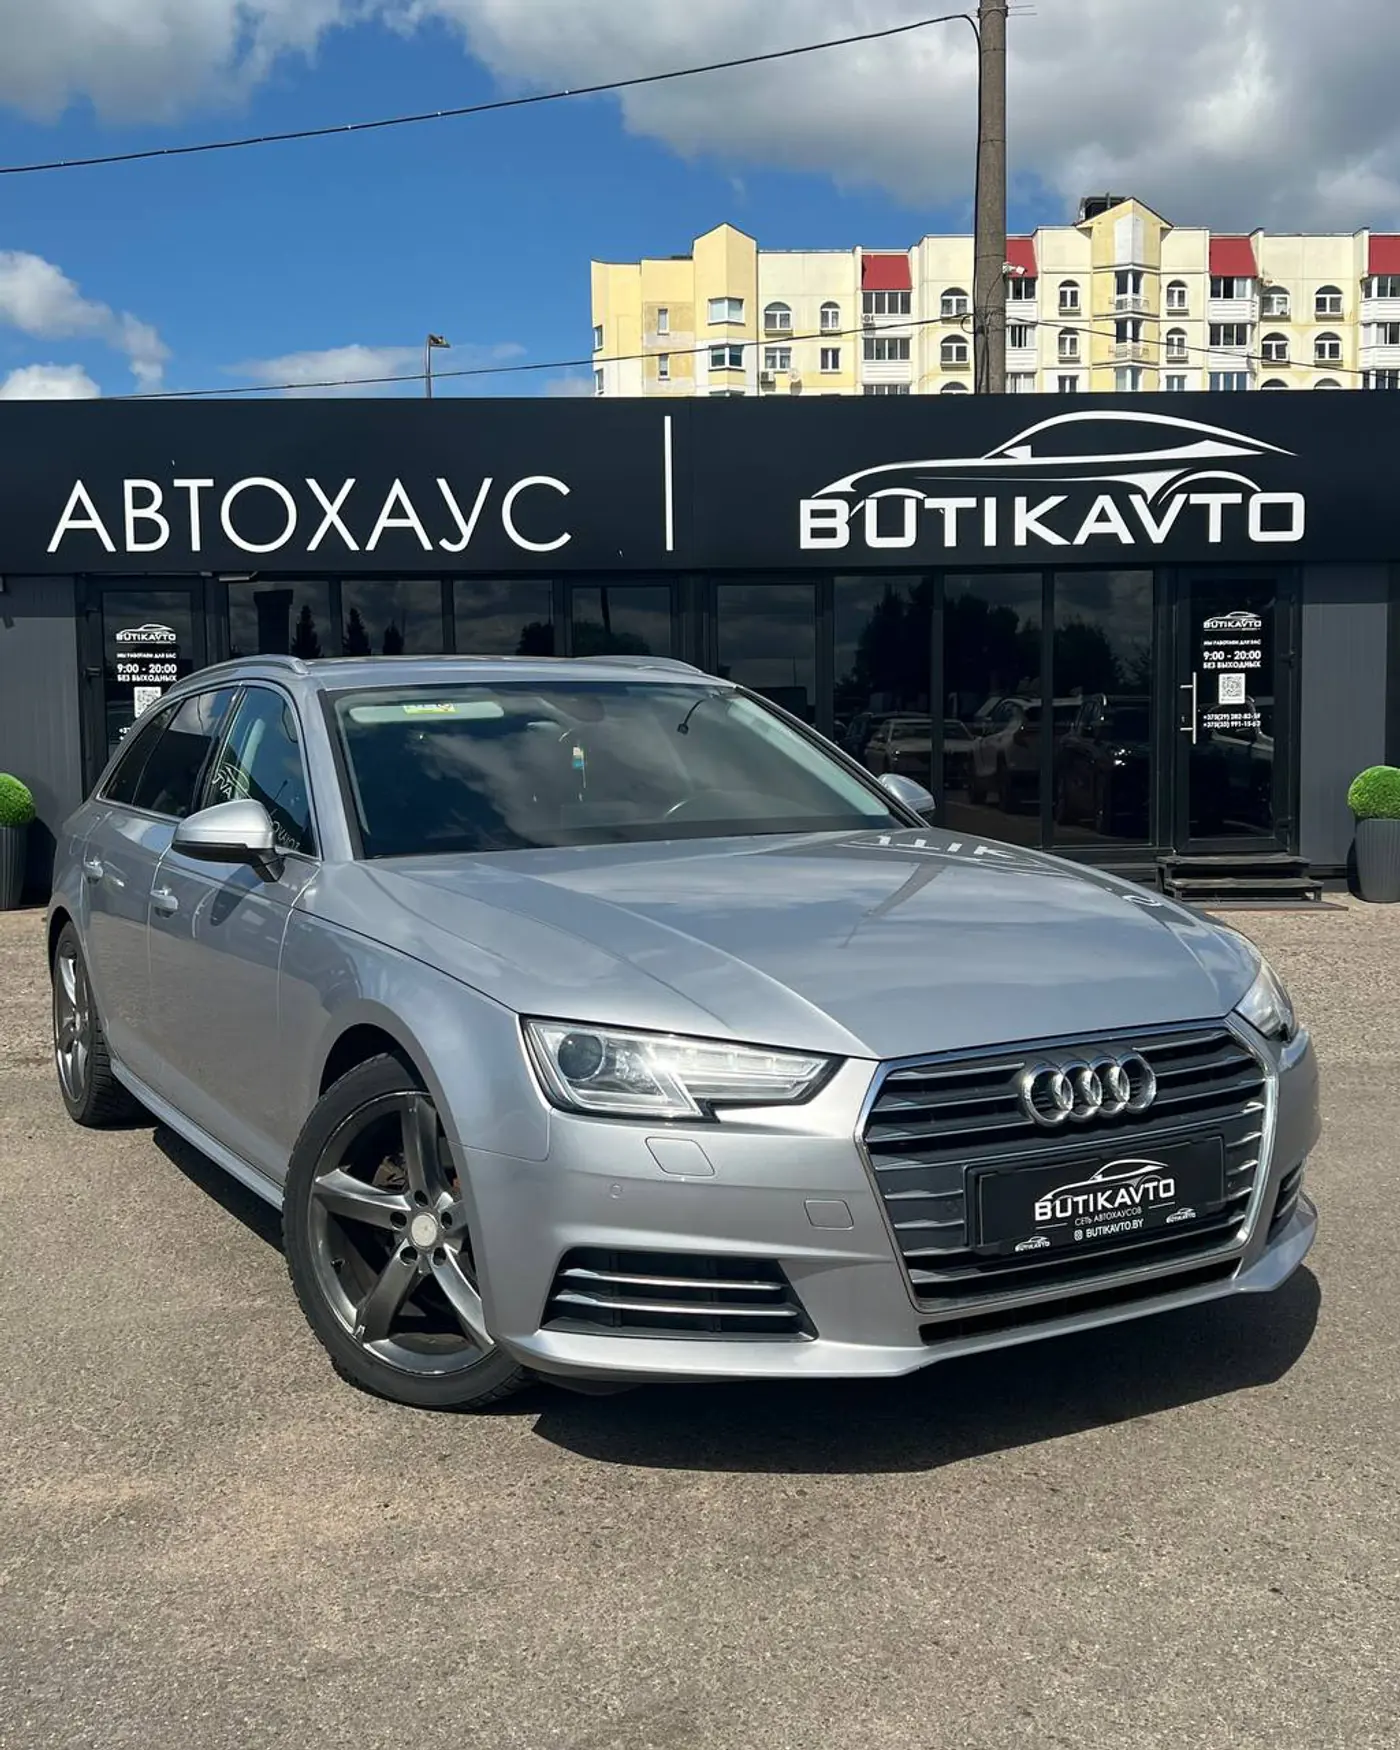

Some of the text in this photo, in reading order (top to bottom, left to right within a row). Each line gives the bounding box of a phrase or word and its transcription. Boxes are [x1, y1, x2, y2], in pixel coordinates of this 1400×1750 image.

[47, 475, 573, 554] АВТОХАУС
[799, 491, 1306, 550] BUTIKAVTO
[1203, 620, 1261, 628] BUTIKAVTO
[115, 633, 176, 641] BUTIKAVTO
[1203, 651, 1225, 660] 9:00
[1234, 650, 1262, 660] 20:00
[116, 663, 139, 674] 9:00
[148, 663, 177, 674] 20:00
[1217, 661, 1262, 669] ВЫХОДНЫХ
[117, 674, 177, 682] БЕЗ ВЫХОДНЫХ
[1034, 1178, 1175, 1221] BUTIKAVTO
[1074, 1206, 1142, 1226] СЕТЬ АВТОХАУСОВ
[1086, 1218, 1144, 1239] BUTIKAVTO.BY
